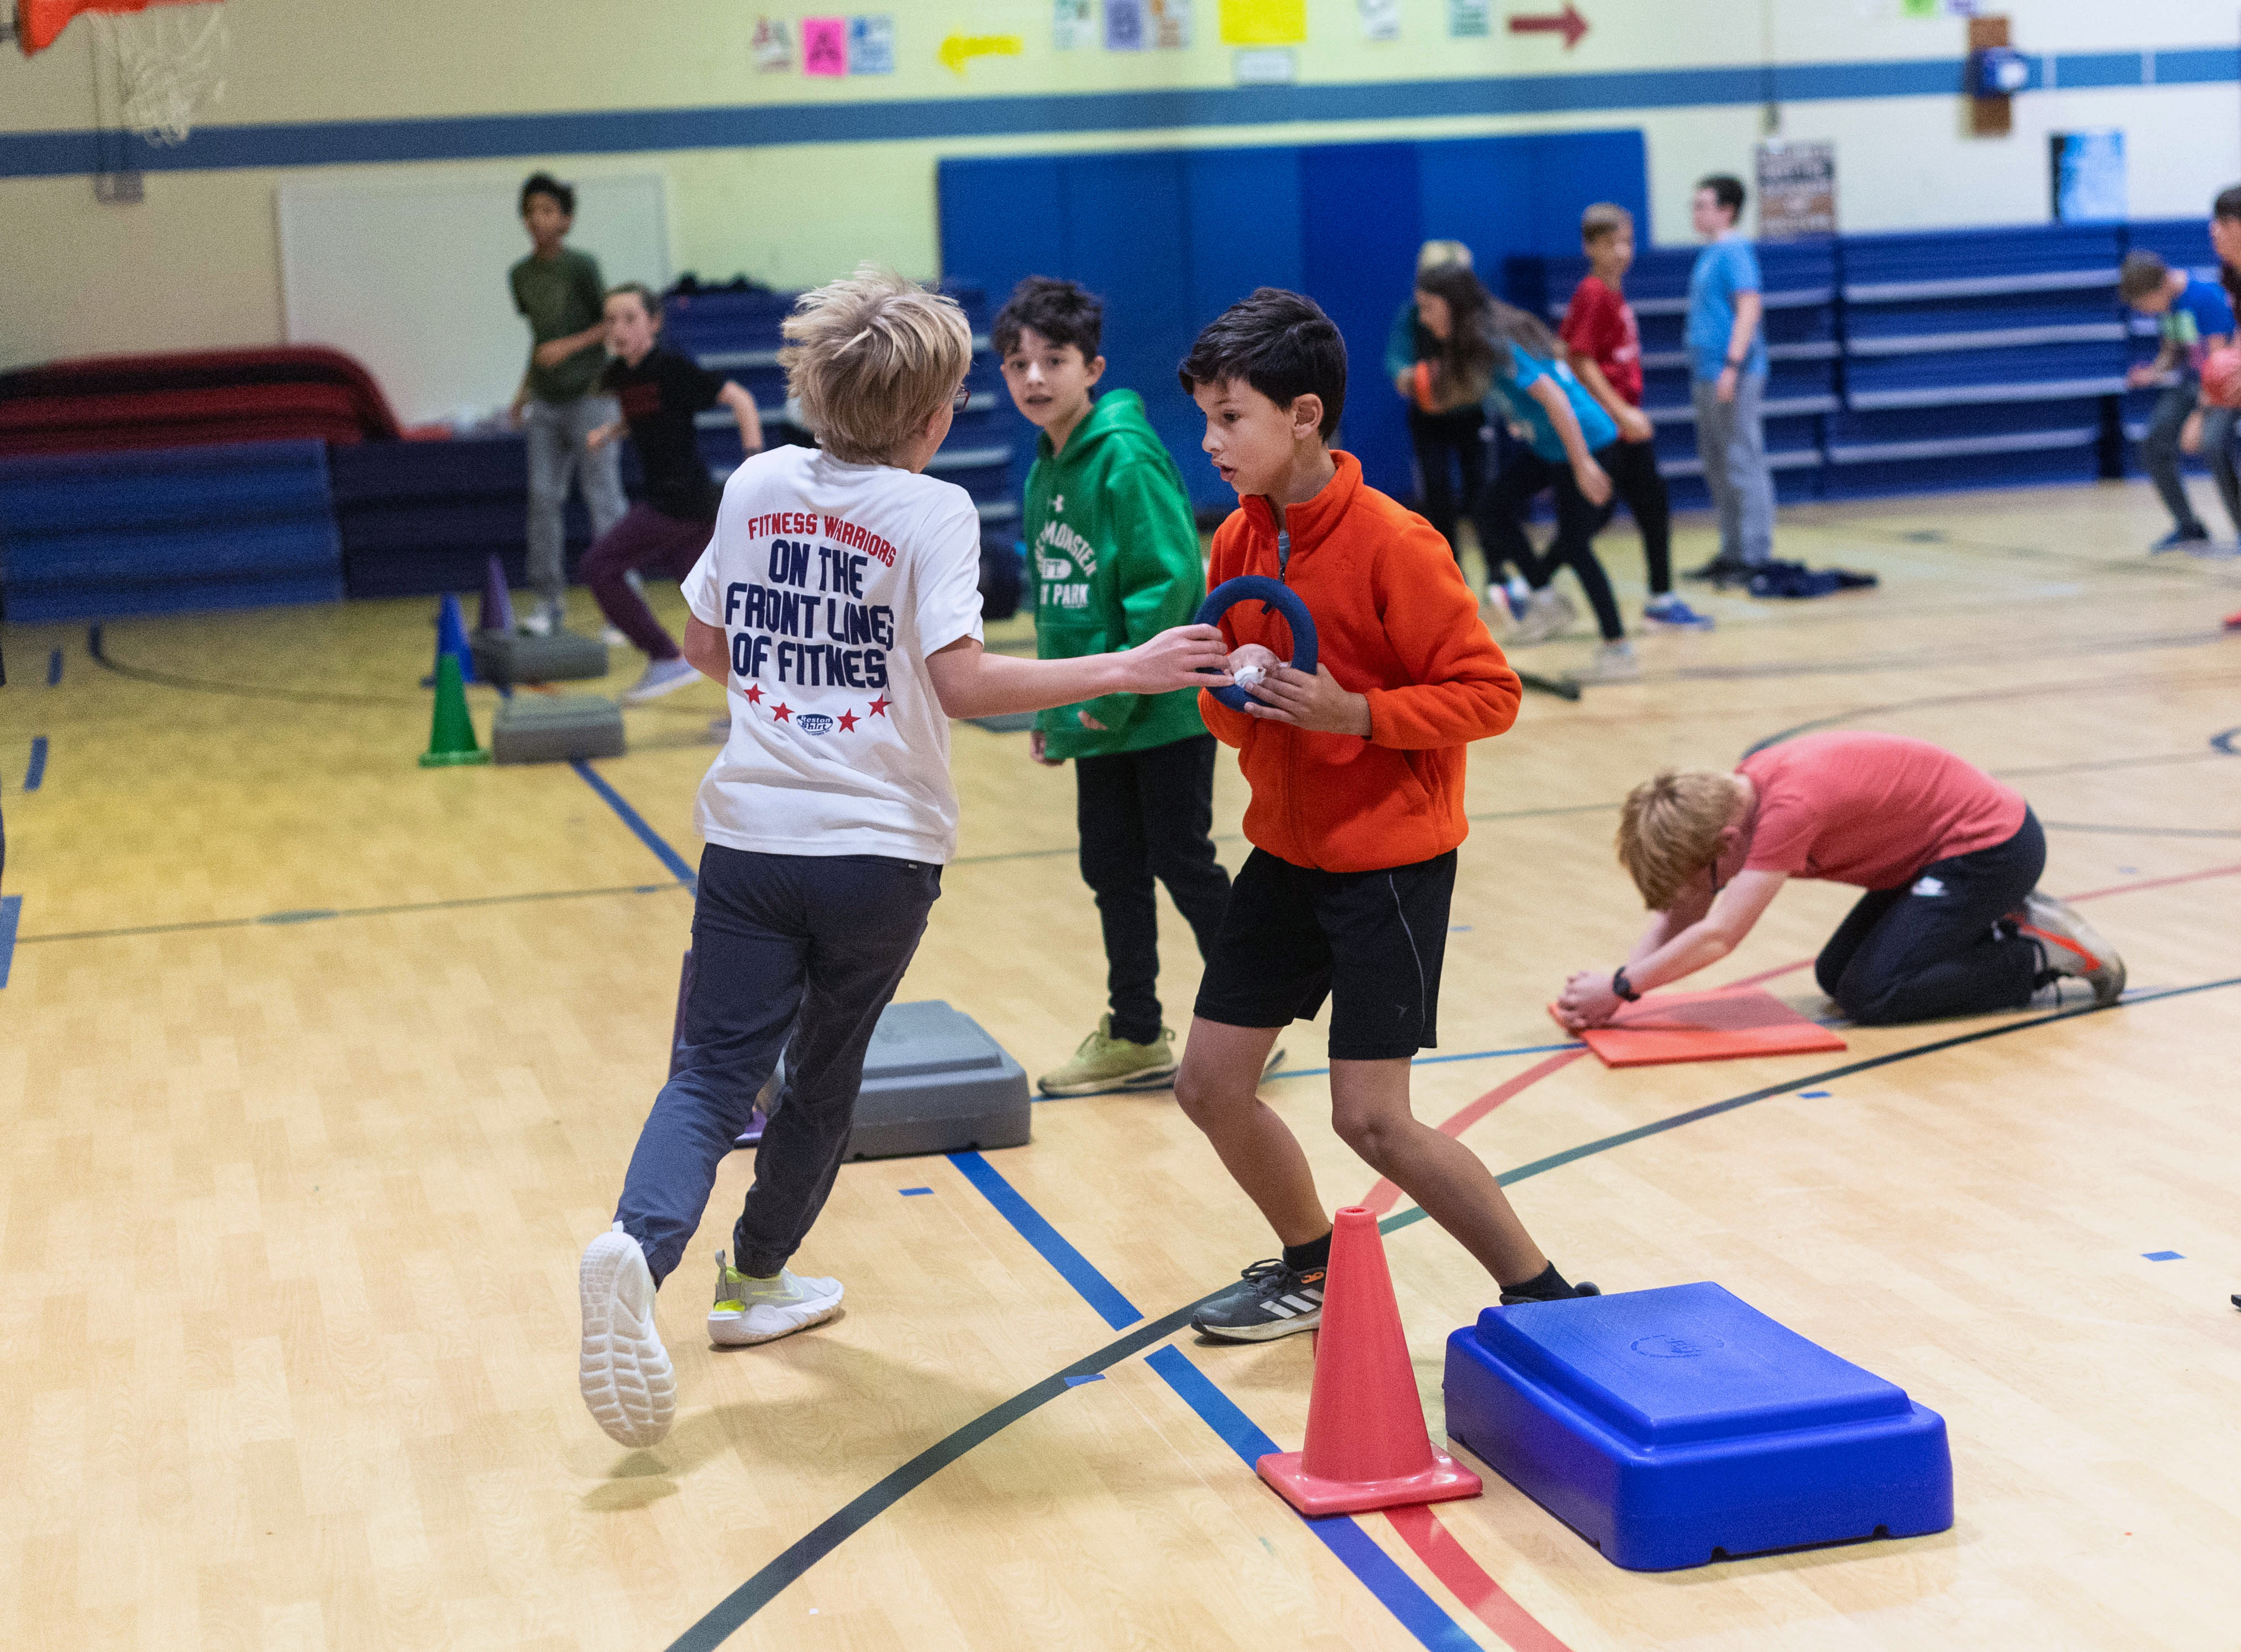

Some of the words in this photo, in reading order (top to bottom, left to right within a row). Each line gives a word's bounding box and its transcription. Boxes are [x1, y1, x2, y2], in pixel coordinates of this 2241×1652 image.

[748, 512, 818, 540] FITNESS
[824, 515, 897, 568] WARRIORS
[769, 538, 811, 588] ON
[818, 546, 868, 600] THE
[1053, 583, 1089, 608] PARK
[725, 582, 821, 639] FRONT
[732, 632, 772, 677] OF
[778, 640, 890, 691] FITNES
